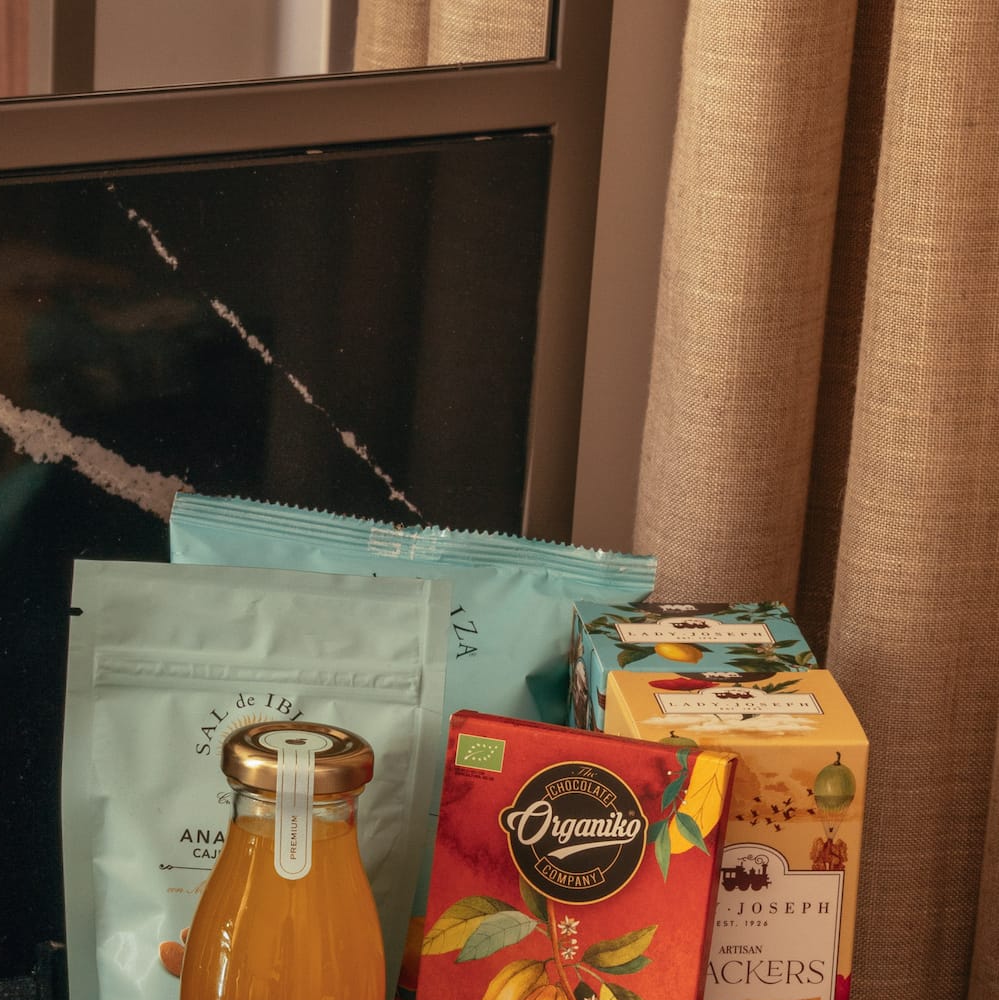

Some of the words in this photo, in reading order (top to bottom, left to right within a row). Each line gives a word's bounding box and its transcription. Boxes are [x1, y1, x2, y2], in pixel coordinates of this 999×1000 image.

[450, 604, 478, 660] IZA
[195, 708, 229, 756] SAL
[236, 692, 255, 709] de
[264, 692, 304, 722] IBI
[549, 779, 613, 804] CHOCOLATE
[290, 815, 298, 860] PREMIUM
[506, 800, 642, 850] Organiko
[193, 848, 221, 859] CAJ
[542, 865, 598, 888] COMPANY
[737, 902, 830, 915] JOSEPH
[718, 945, 763, 955] ARTISAN
[706, 959, 825, 985] ACKERS
